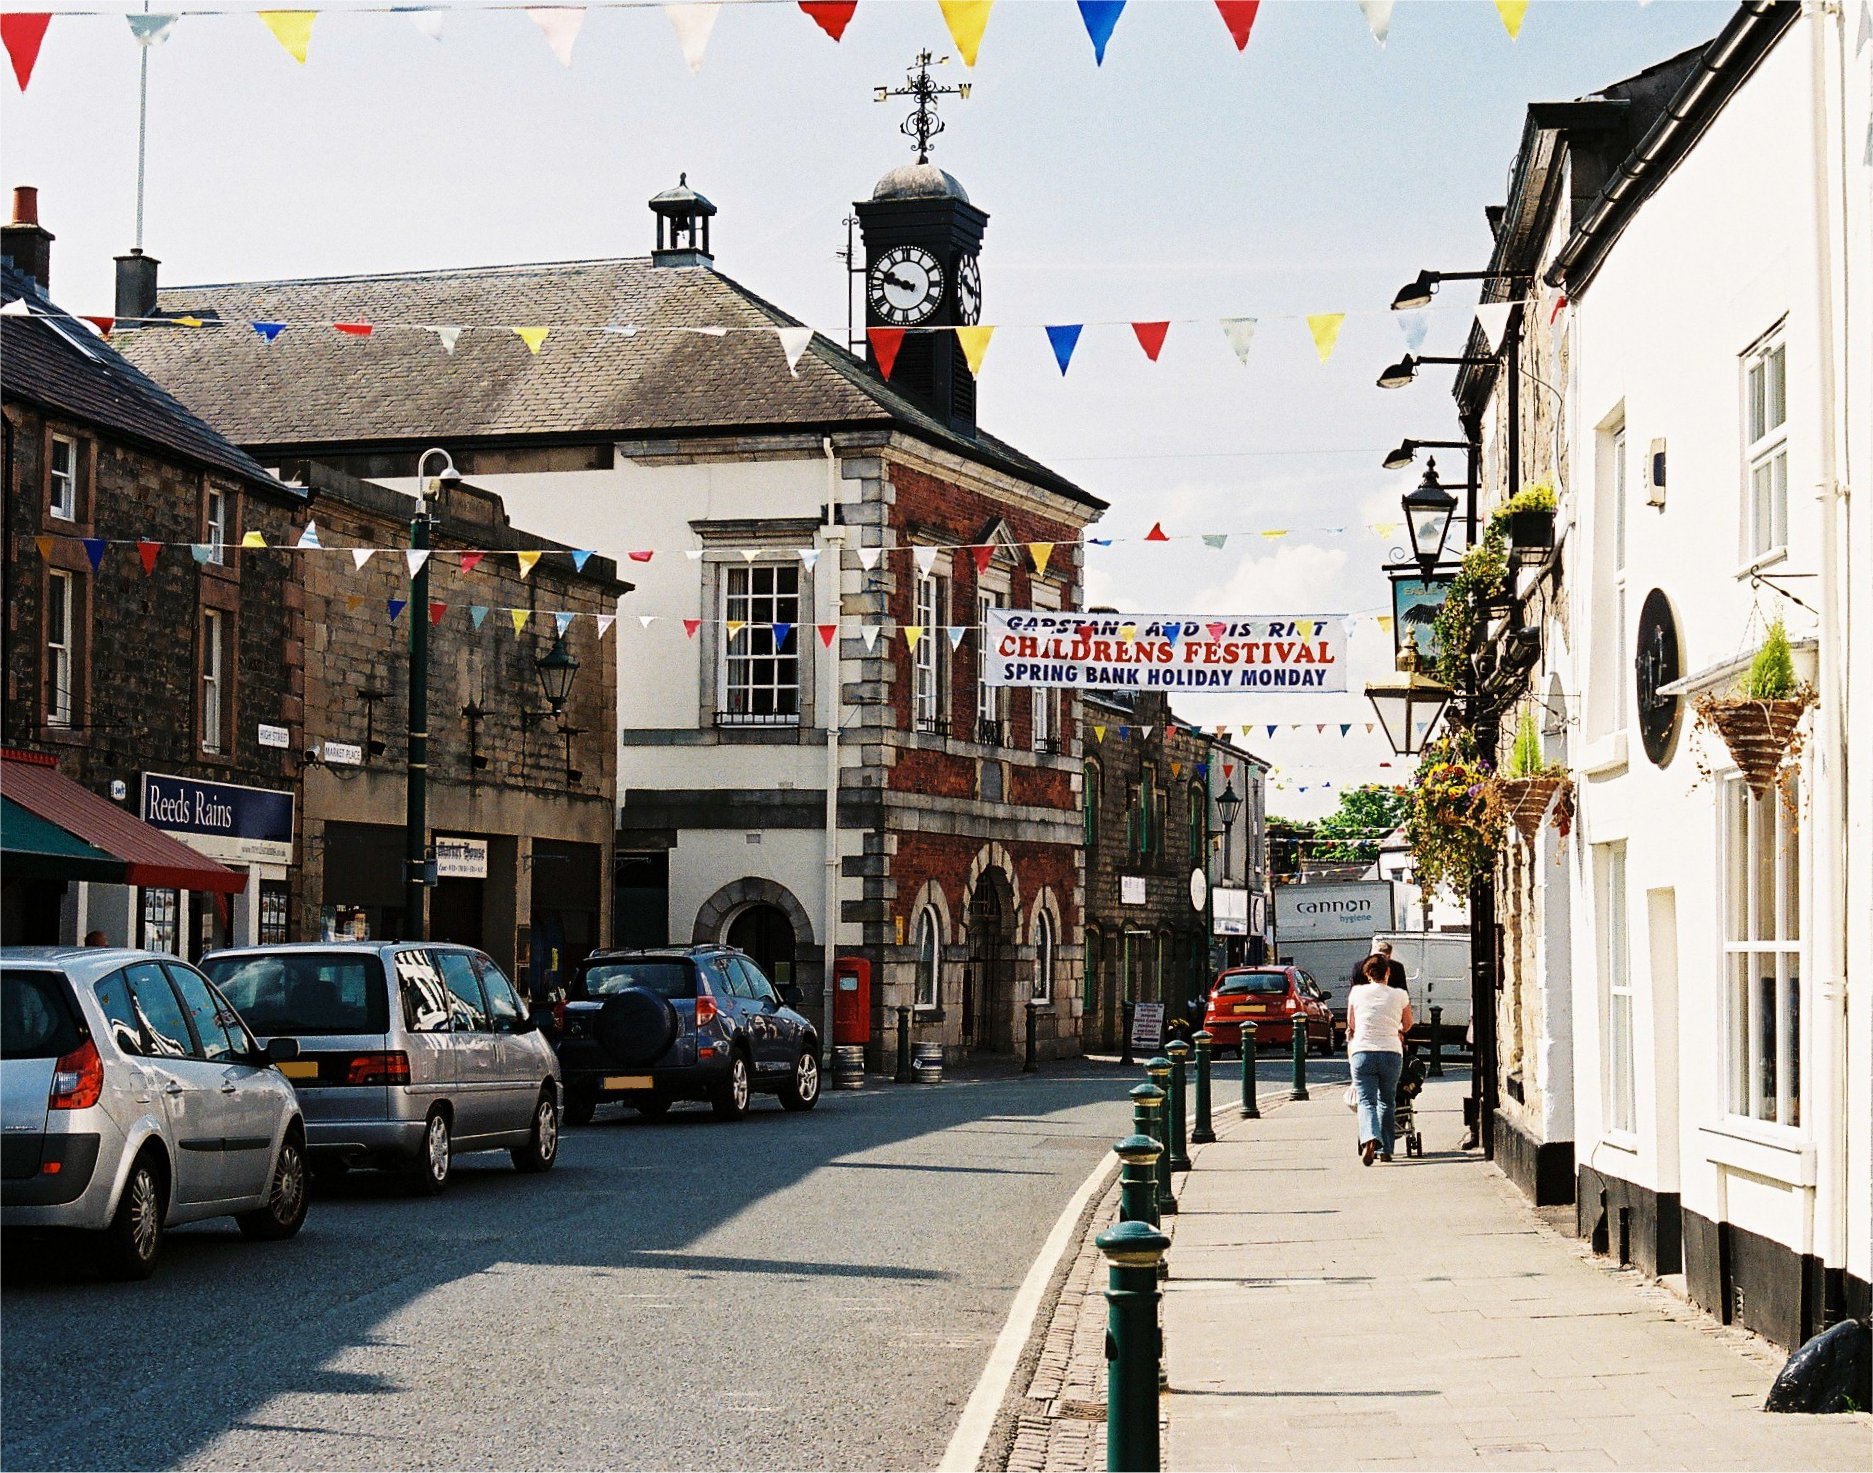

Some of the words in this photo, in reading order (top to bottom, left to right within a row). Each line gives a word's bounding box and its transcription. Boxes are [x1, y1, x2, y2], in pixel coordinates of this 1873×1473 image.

[998, 635, 1174, 663] CHILDRENS
[1183, 641, 1335, 663] FESTIVAL
[1004, 663, 1077, 682] SPRING
[1086, 666, 1139, 685] BANK
[1147, 668, 1233, 686] HOLIDAY
[1240, 668, 1327, 687] MONDAY
[272, 731, 288, 743] STREET
[325, 746, 345, 758] MARKET
[346, 749, 361, 761] PLACE
[149, 785, 190, 824] Reeds
[195, 790, 232, 828] Rains
[1296, 899, 1371, 914] cannon
[1339, 913, 1372, 924] hygiene
